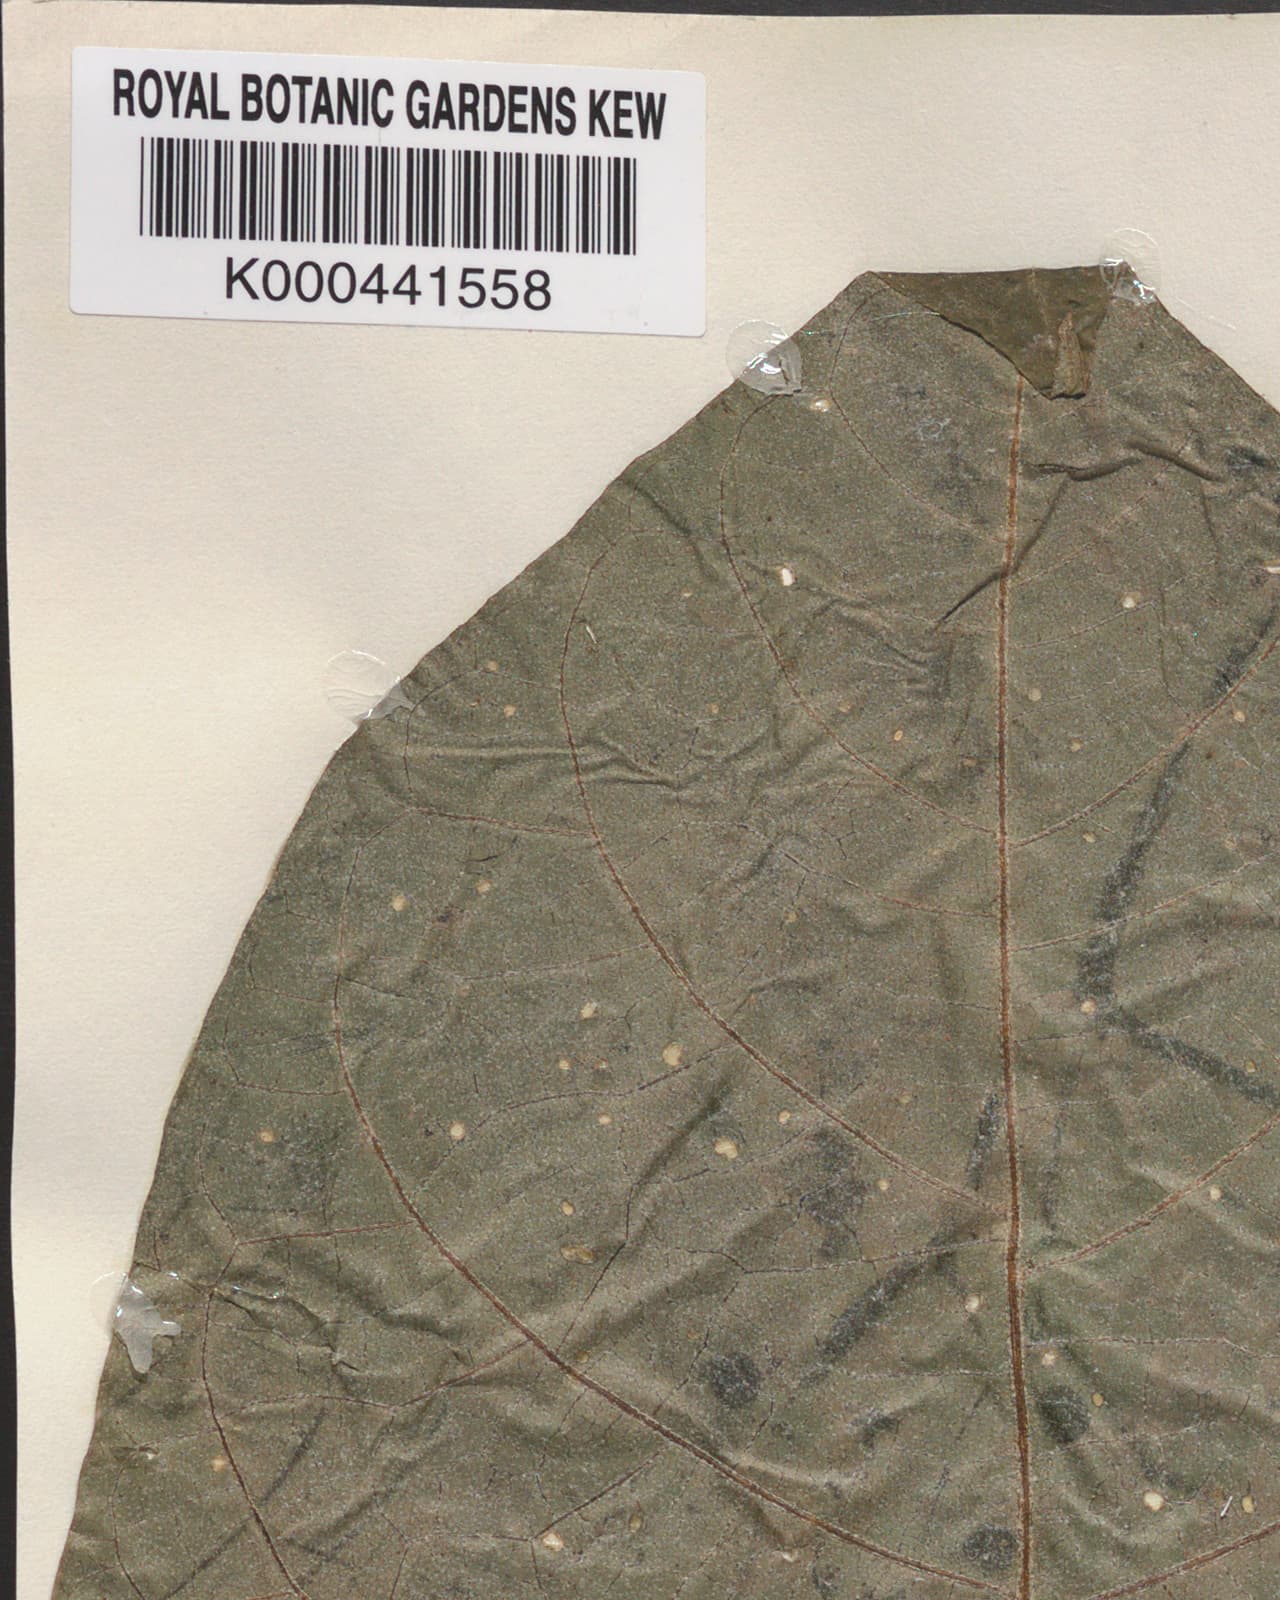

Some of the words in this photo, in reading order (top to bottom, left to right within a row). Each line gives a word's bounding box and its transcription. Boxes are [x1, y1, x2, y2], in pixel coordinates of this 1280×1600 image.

[114, 69, 229, 120] ROYAL
[242, 74, 394, 128] BOTANIC
[406, 80, 576, 136] GARDENS
[589, 89, 666, 139] KEW
[226, 257, 551, 311] K000441558
